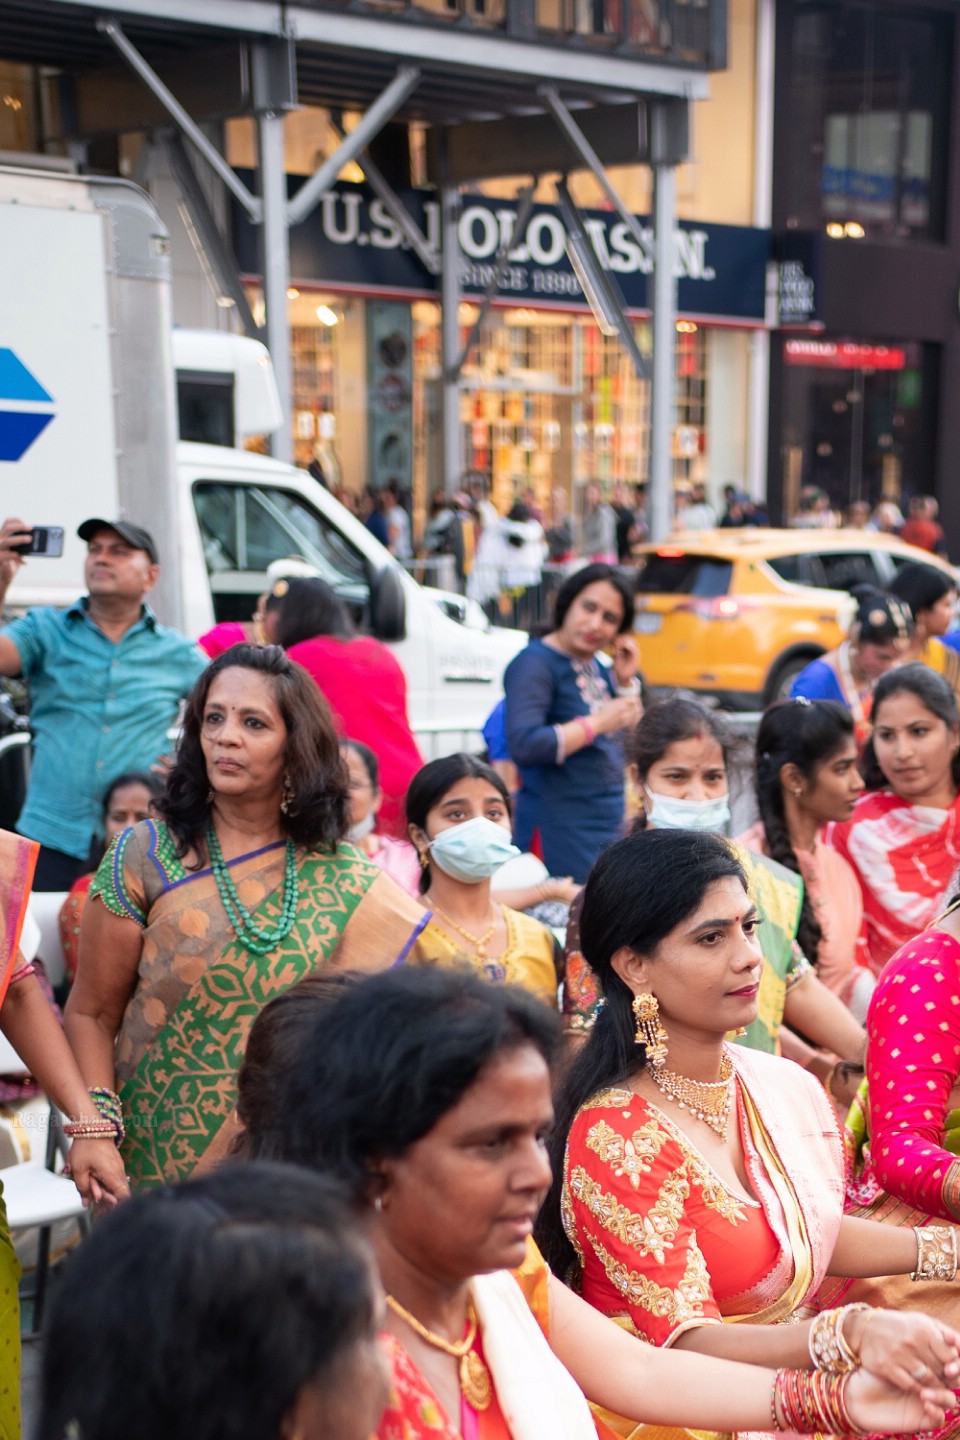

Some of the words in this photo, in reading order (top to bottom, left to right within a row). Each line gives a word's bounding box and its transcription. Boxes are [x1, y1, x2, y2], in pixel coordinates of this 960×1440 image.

[320, 191, 411, 250] U.S.
[582, 218, 716, 281] SN.
[459, 263, 528, 291] SINCE
